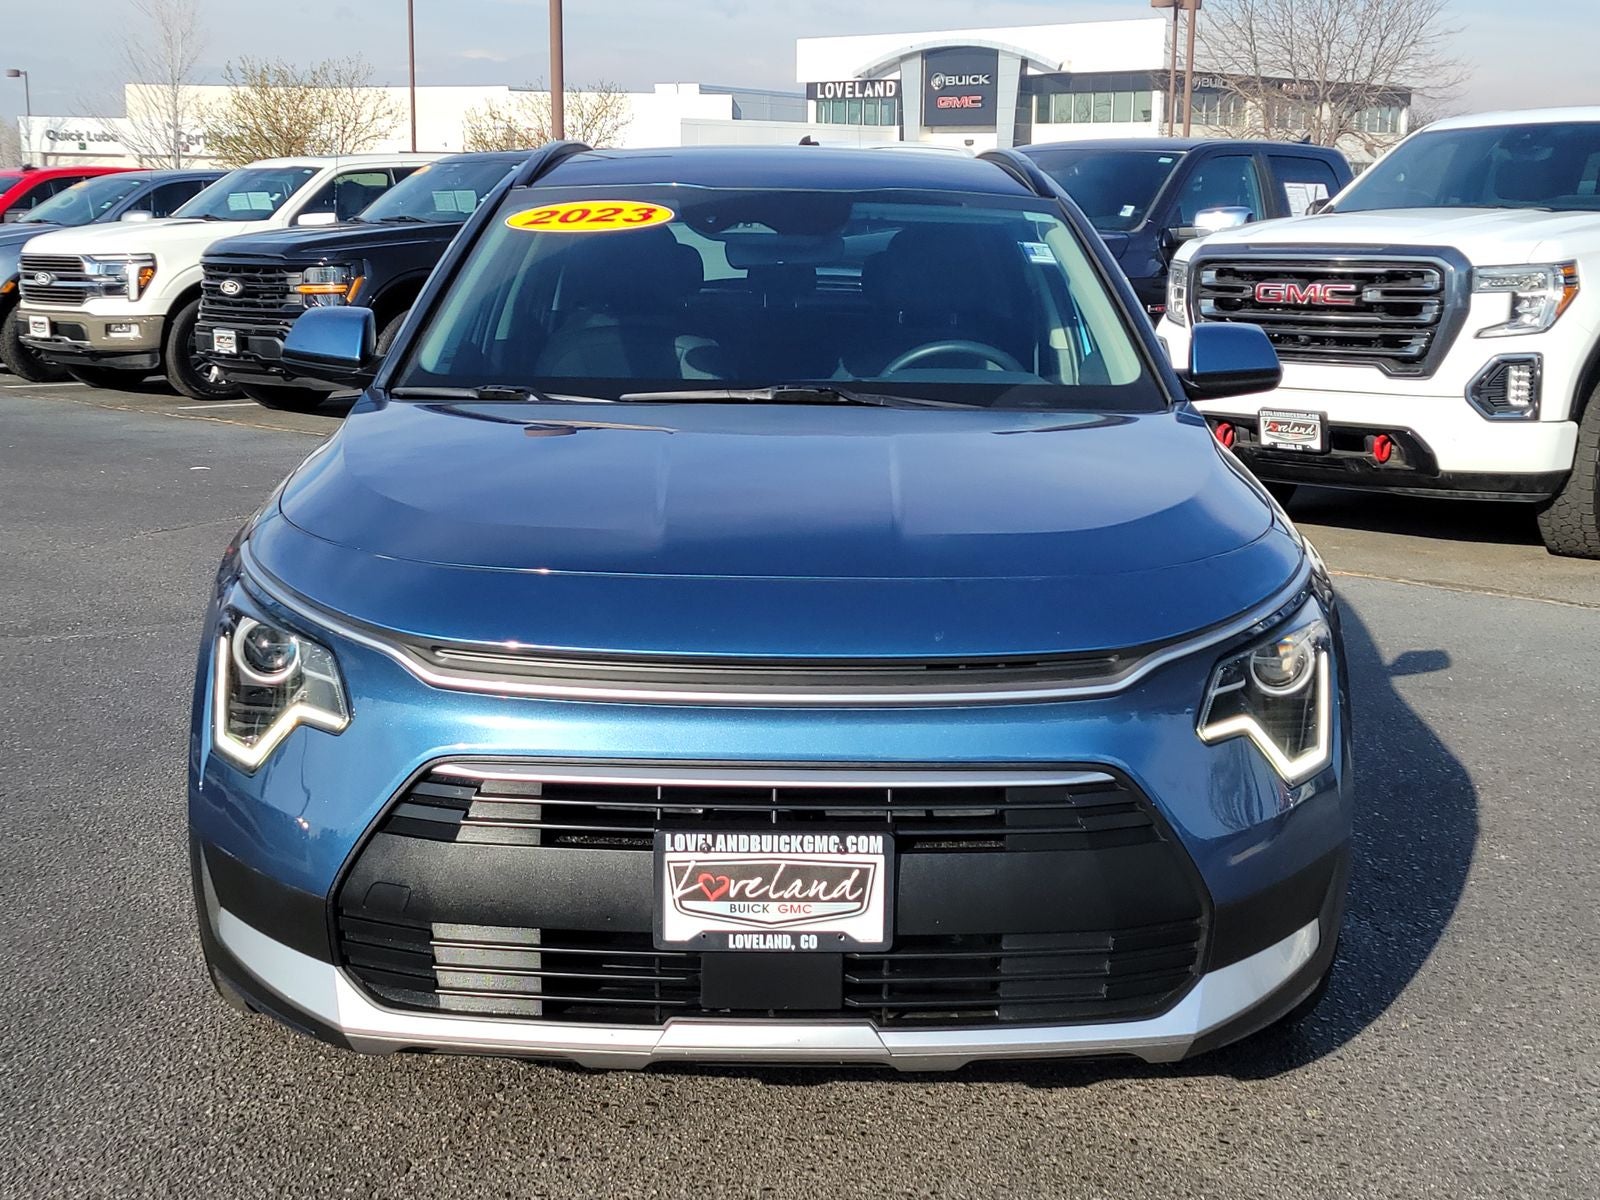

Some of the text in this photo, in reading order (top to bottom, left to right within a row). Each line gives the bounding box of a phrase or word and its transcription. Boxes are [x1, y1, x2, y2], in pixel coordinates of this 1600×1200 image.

[944, 74, 990, 85] BUICK
[816, 81, 896, 98] LOVELAND
[937, 95, 982, 108] GMC
[45, 129, 119, 142] Quick Lube
[523, 207, 657, 226] 2023
[1255, 282, 1356, 305] GMC
[729, 903, 813, 914] BUICK GMC
[728, 933, 818, 951] LOVELAND, CO
